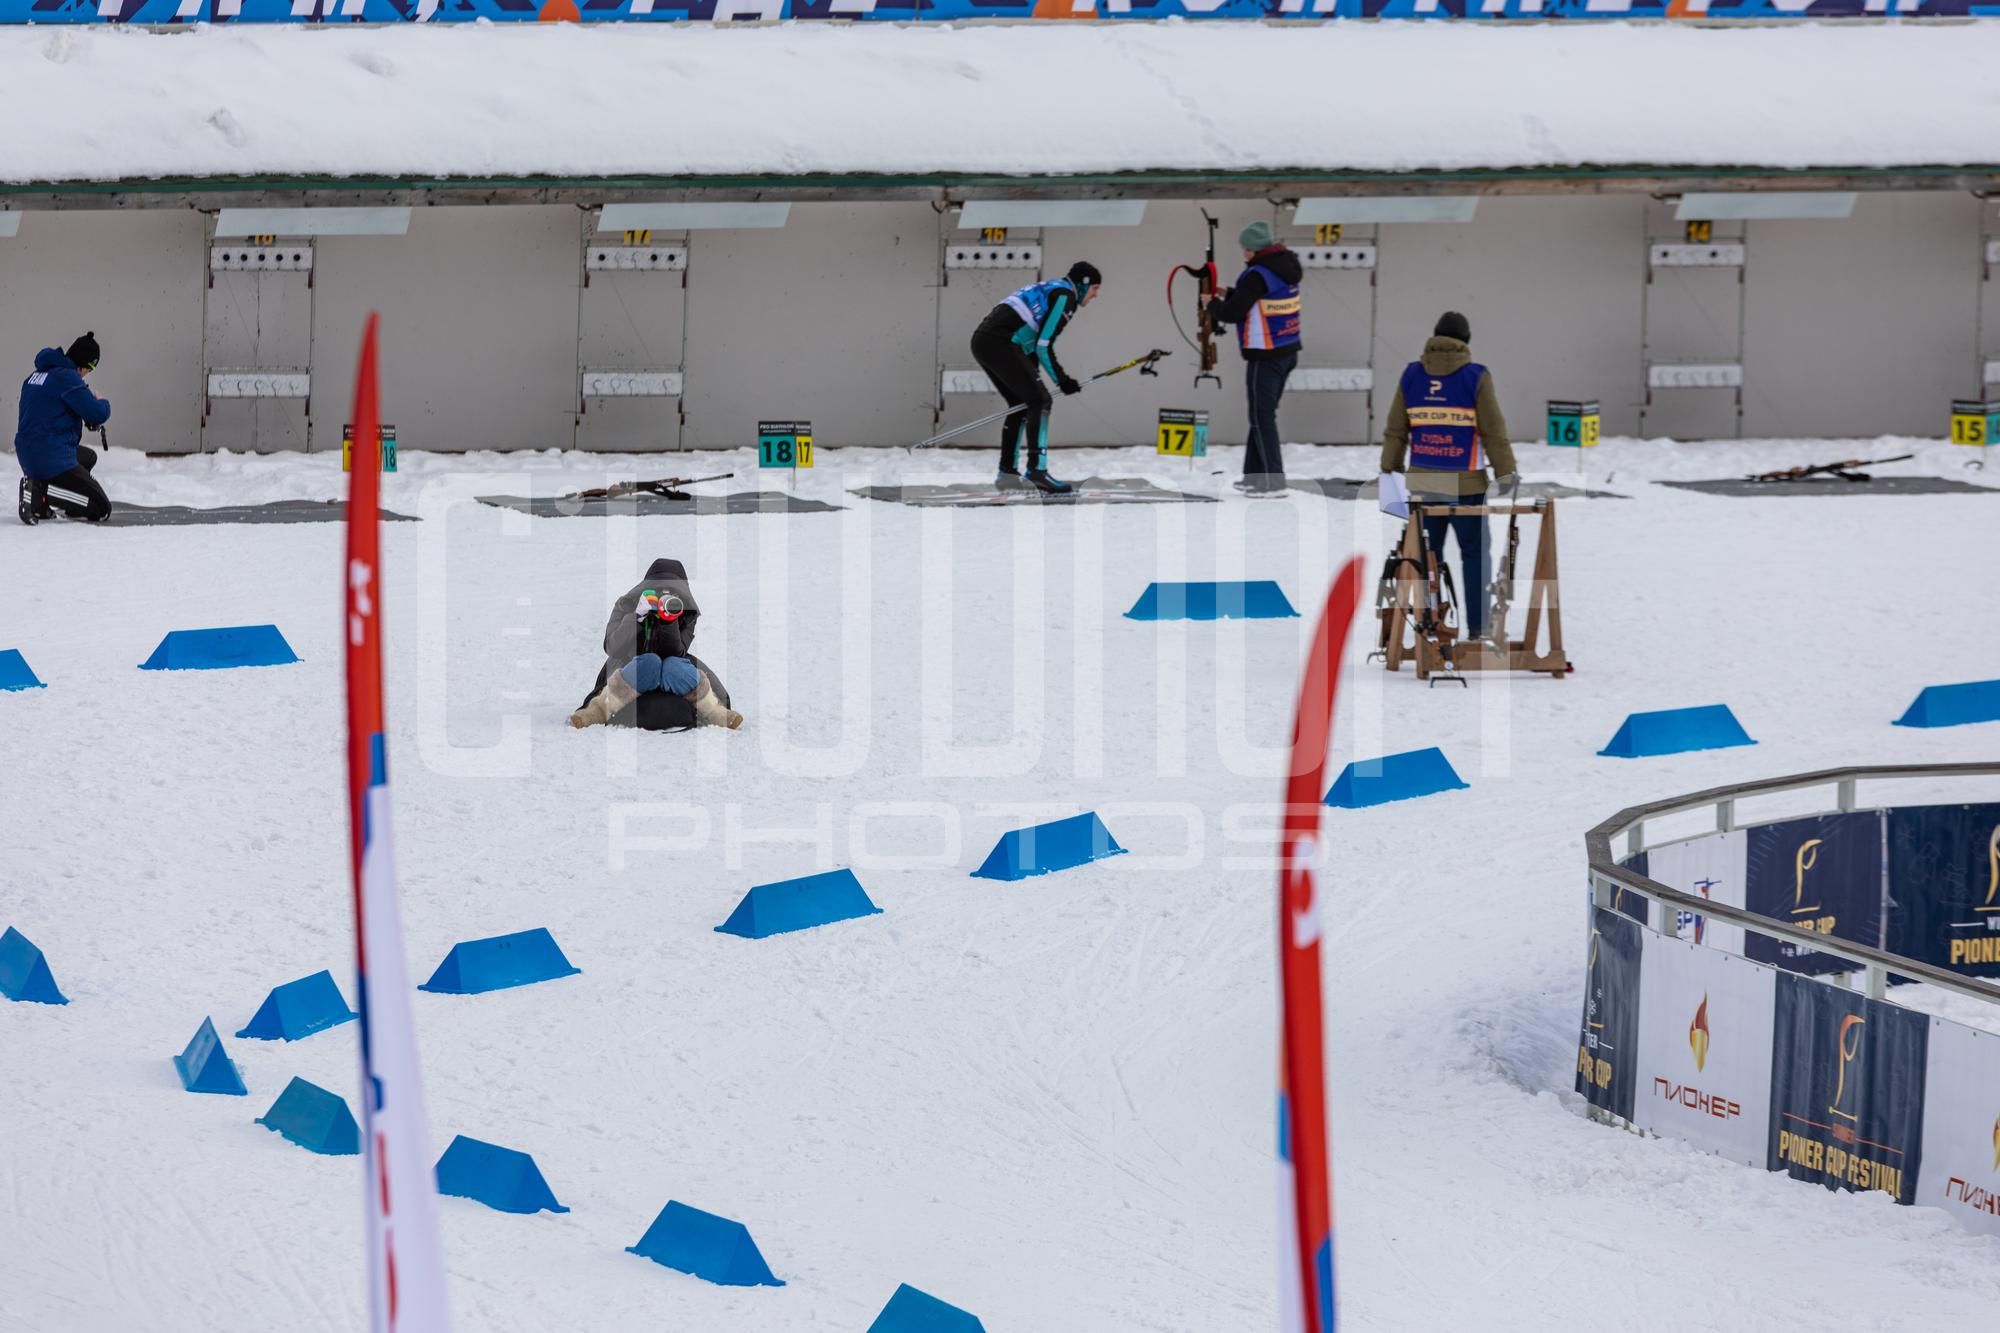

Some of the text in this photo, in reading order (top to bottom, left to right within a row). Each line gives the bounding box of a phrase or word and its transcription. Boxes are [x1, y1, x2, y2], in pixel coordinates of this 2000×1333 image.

[986, 228, 1004, 244] 16
[1319, 224, 1341, 245] 15
[27, 372, 49, 386] TEAM
[1161, 429, 1190, 450] 17
[1551, 421, 1577, 442] 16
[1584, 421, 1597, 441] 15
[1956, 420, 1981, 441] 15
[384, 446, 395, 467] 18
[763, 441, 792, 463] 18
[798, 442, 810, 463] 17
[1595, 1059, 1612, 1090] CUP
[1655, 1077, 1740, 1119] ПИОНЕР
[1779, 1130, 1902, 1199] PIONER CUP FESTIVAL
[1946, 1177, 2000, 1216] ПИОН
